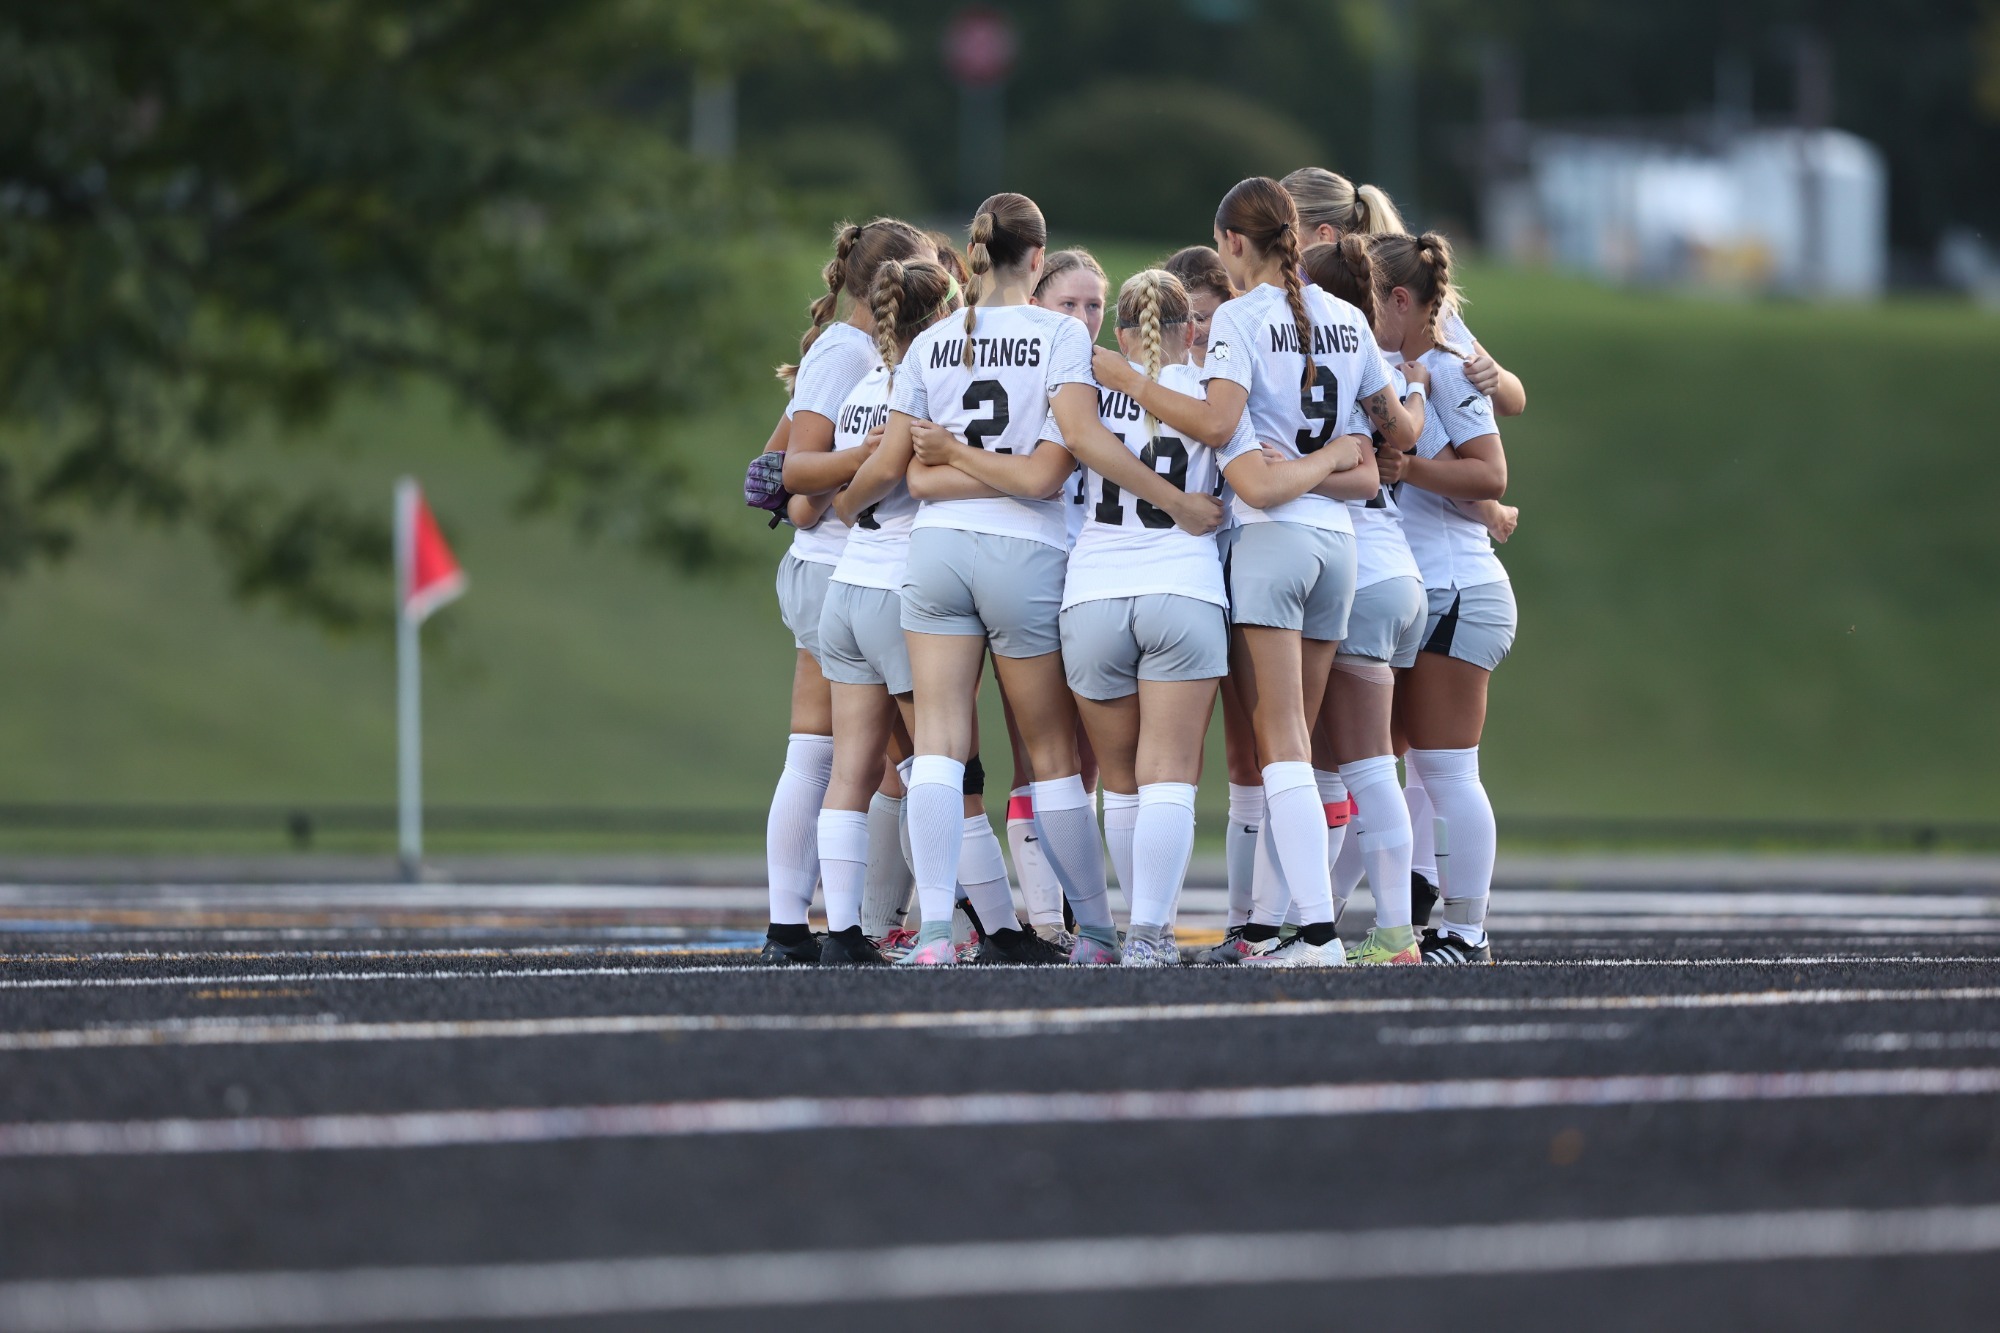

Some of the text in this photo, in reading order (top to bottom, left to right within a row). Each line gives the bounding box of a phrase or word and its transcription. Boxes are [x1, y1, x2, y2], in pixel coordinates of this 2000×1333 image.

[1269, 323, 1359, 355] MUANGS
[962, 379, 1013, 455] 2
[1295, 365, 1338, 455] 9
